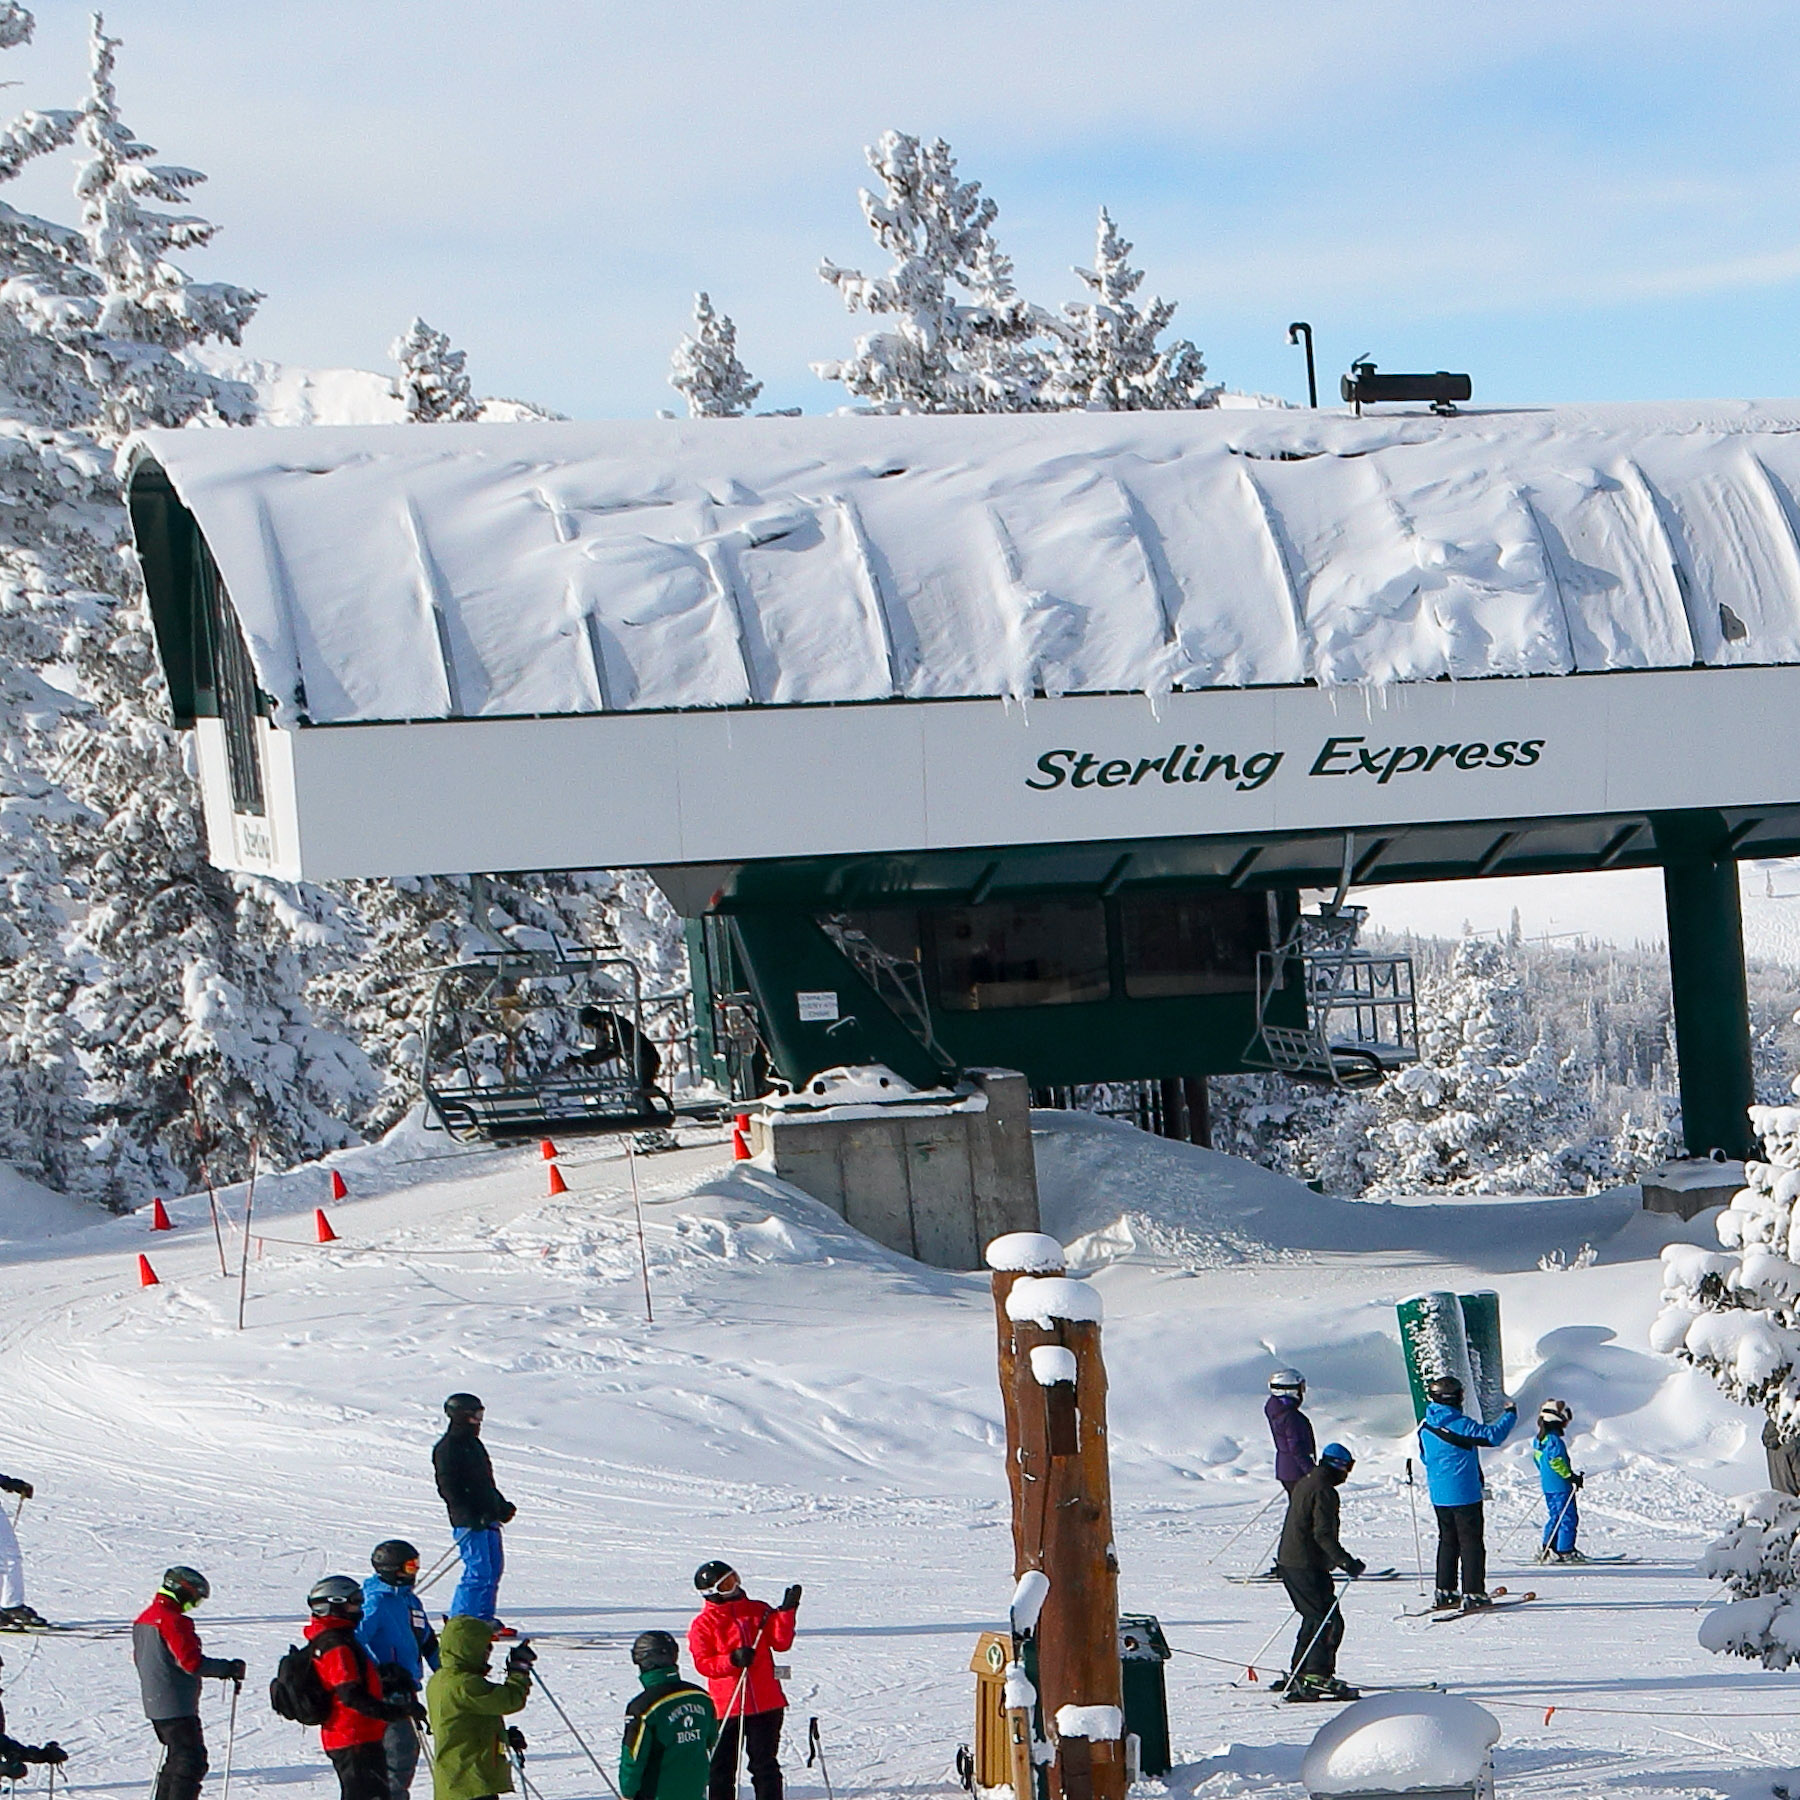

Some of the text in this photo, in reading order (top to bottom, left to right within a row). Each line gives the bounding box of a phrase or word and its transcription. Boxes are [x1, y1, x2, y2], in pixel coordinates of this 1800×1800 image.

[1025, 735, 1546, 792] Sterling Express
[676, 1728, 702, 1744] HOST
